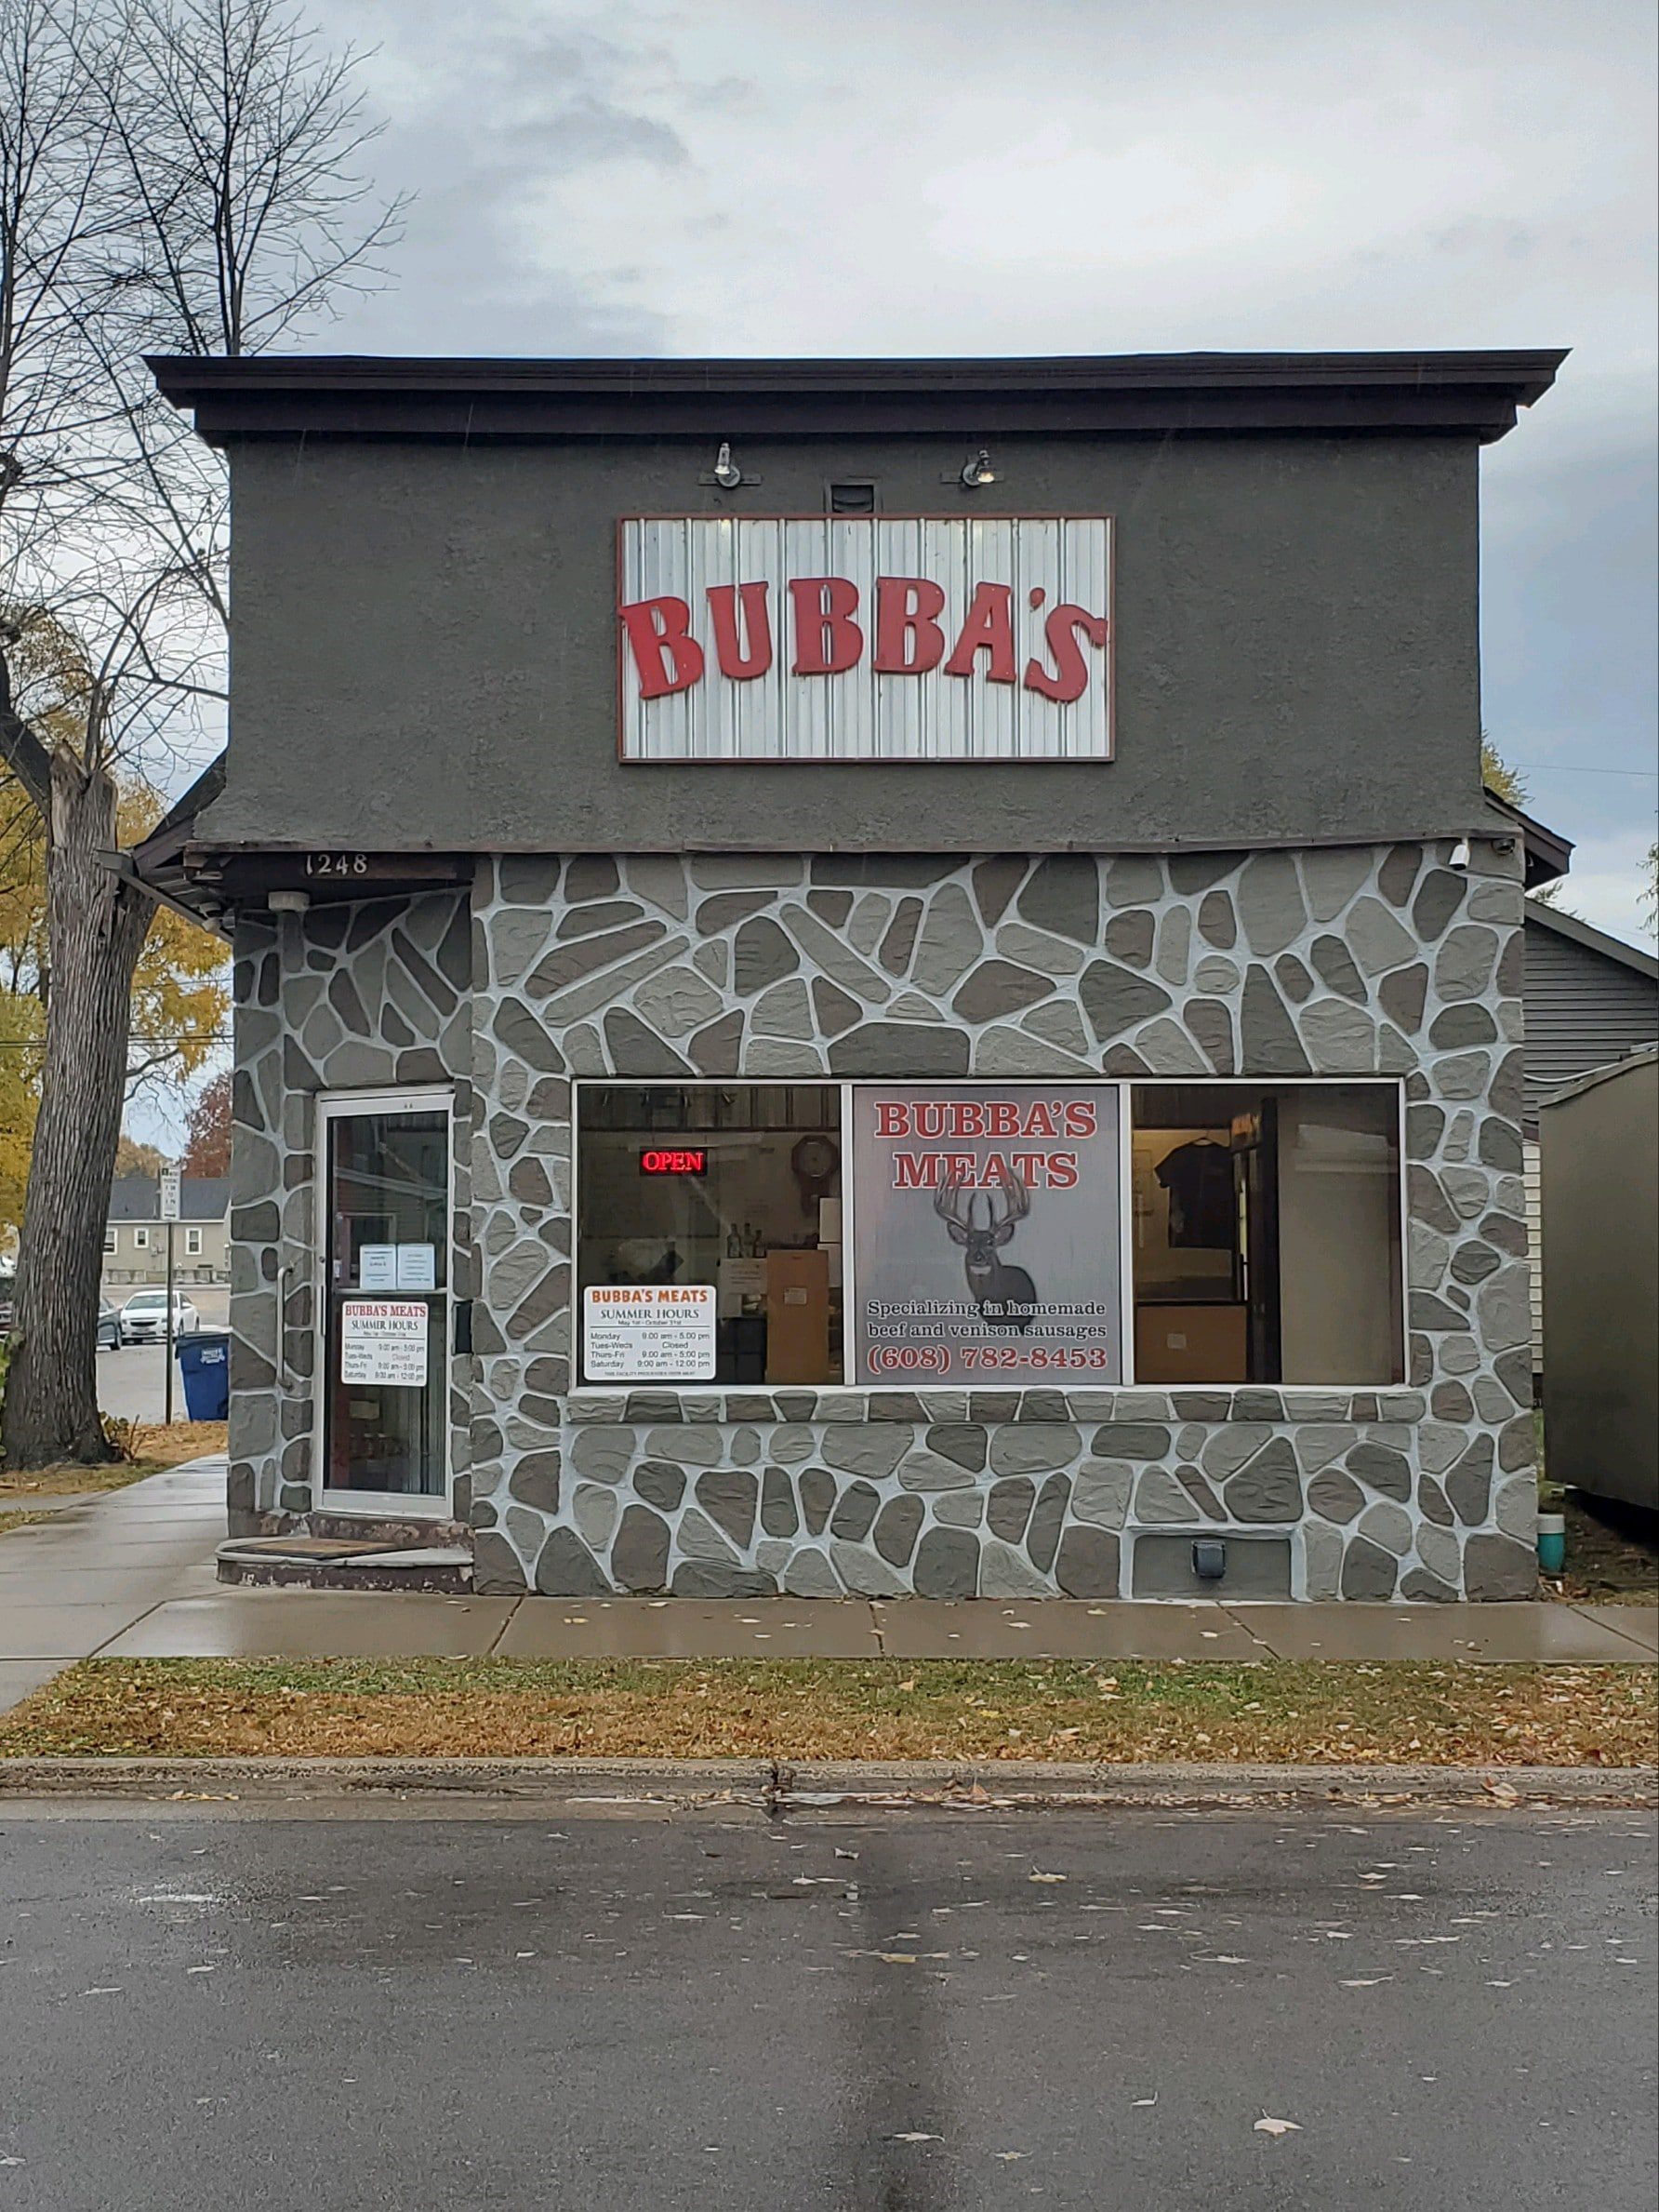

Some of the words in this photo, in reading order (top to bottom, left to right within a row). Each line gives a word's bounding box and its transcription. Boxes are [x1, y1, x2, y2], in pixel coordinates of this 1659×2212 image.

[618, 576, 1108, 704] BUBBA'S
[306, 853, 367, 875] 1248
[875, 1101, 1097, 1139] BUBBA'S
[643, 1152, 704, 1171] OPEN
[893, 1152, 1079, 1190] MEATS
[592, 1289, 653, 1303] BUBBA'S
[657, 1290, 708, 1303] MEATS
[345, 1305, 388, 1316] BUBBA'S
[390, 1305, 427, 1317] MEATS
[601, 1309, 653, 1319] SUMMER
[657, 1309, 699, 1319] HOURS
[867, 1299, 979, 1319] Specializing
[983, 1299, 1005, 1316] in
[1006, 1299, 1107, 1315] homemade
[352, 1320, 386, 1330] SUMMER
[389, 1320, 418, 1331] HOURS
[867, 1322, 908, 1338] beef
[909, 1322, 946, 1338] and
[949, 1322, 1021, 1338] venison
[1023, 1324, 1107, 1341] sausages
[591, 1360, 624, 1368] Saturday
[867, 1344, 952, 1376] (608)
[960, 1345, 1108, 1370] 782-8453
